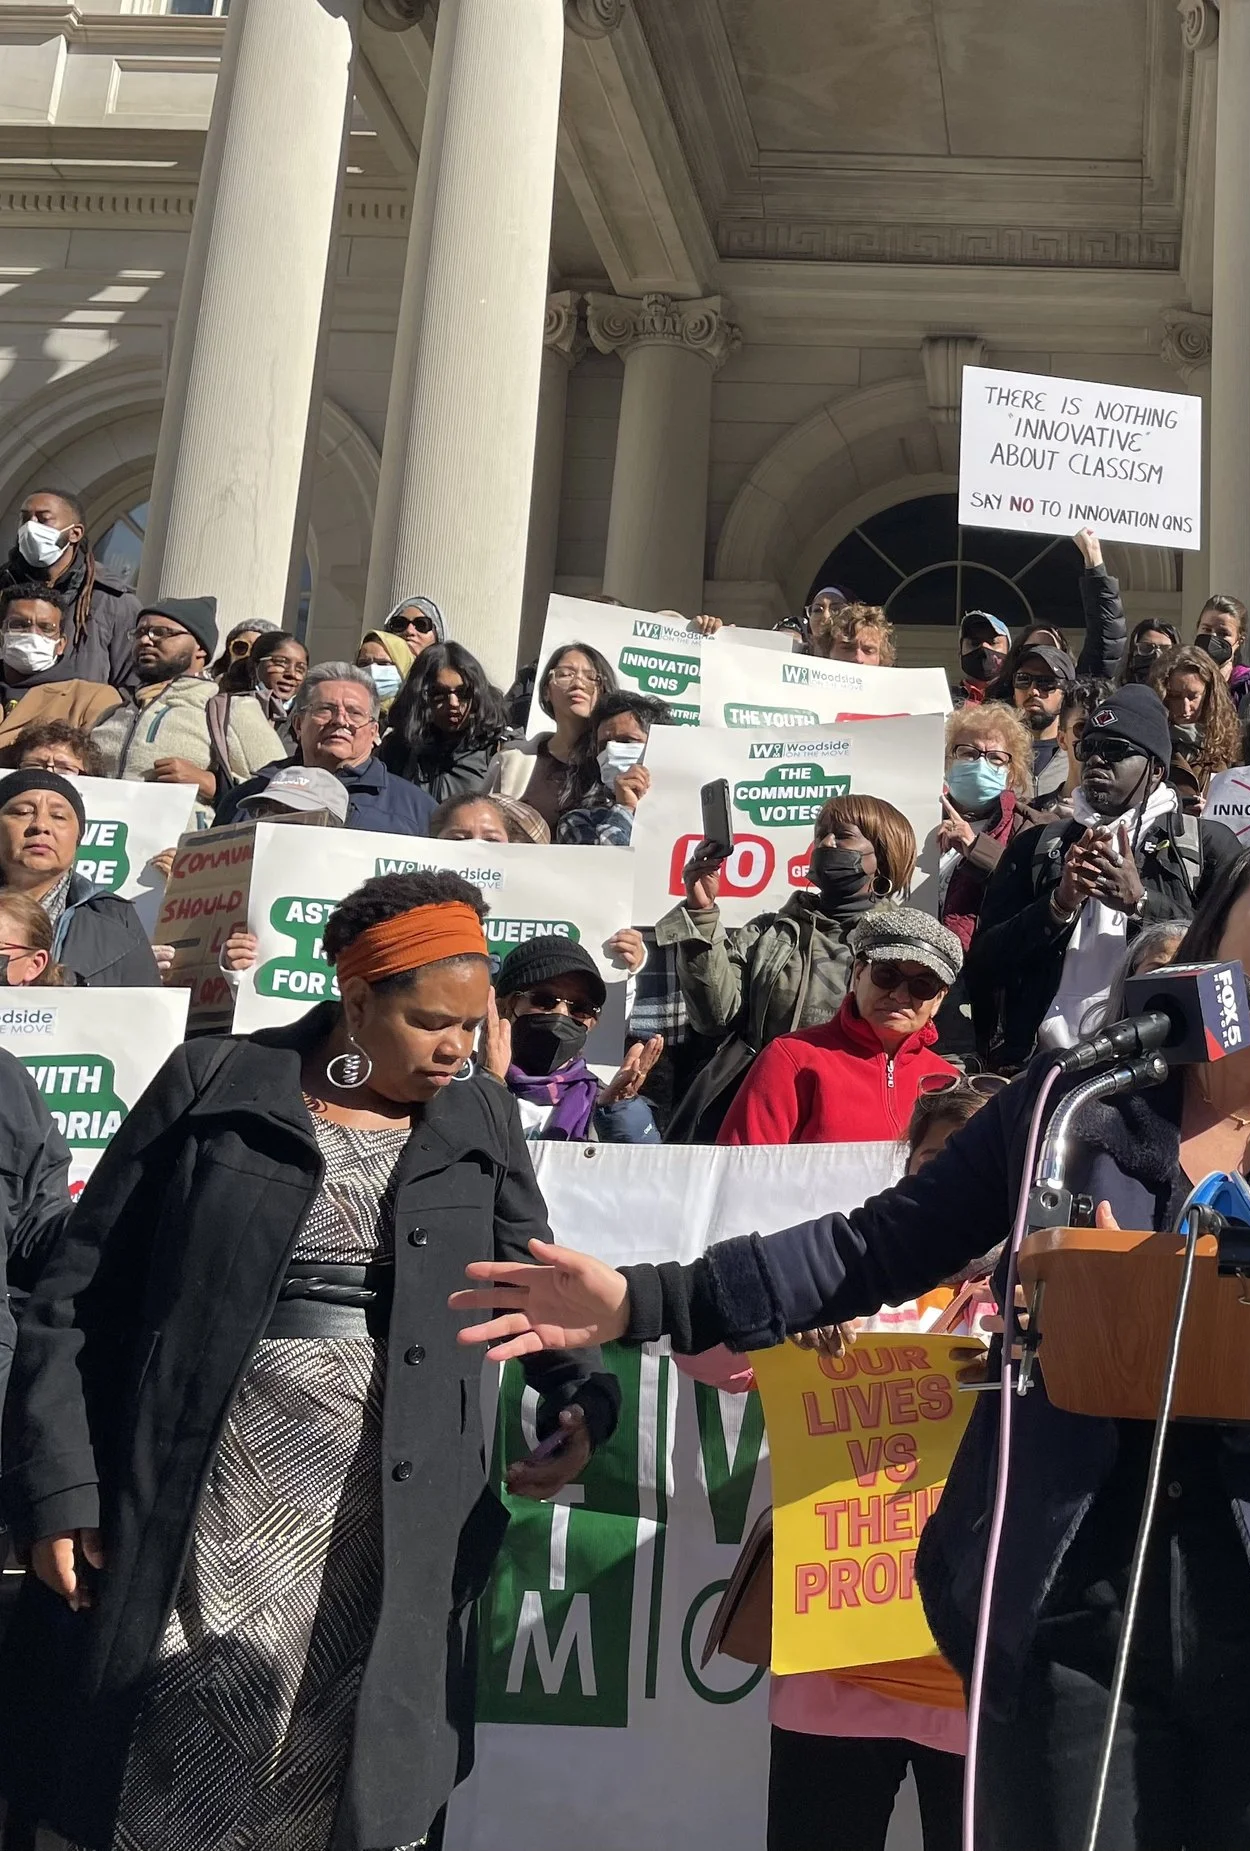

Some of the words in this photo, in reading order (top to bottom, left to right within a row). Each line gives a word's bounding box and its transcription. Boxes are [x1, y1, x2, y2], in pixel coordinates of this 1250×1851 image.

[984, 386, 1047, 411] THERE
[1060, 396, 1082, 416] IS
[1095, 400, 1178, 429] NOTHING
[990, 442, 1059, 471] ABOUT
[1069, 453, 1163, 484] CLASSISM
[970, 491, 1003, 509] SAY
[1009, 496, 1034, 512] NO
[1039, 500, 1062, 517] TO
[1068, 503, 1160, 528] INNOVATION
[1162, 514, 1193, 533] QNS
[622, 652, 700, 676] INNOVATIO
[812, 669, 864, 685] Woodside
[648, 677, 678, 691] QNS
[729, 708, 760, 726] THE
[787, 741, 849, 752] Woodside
[778, 767, 812, 780] THE
[736, 784, 847, 800] COMMUNITY
[161, 891, 242, 923] SHOULD
[272, 969, 325, 996] FOR
[11, 1024, 53, 1034] MOVE
[817, 1346, 931, 1381] OUR
[801, 1376, 953, 1436] LIVES
[846, 1433, 919, 1489] VS
[815, 1487, 945, 1551] THEI
